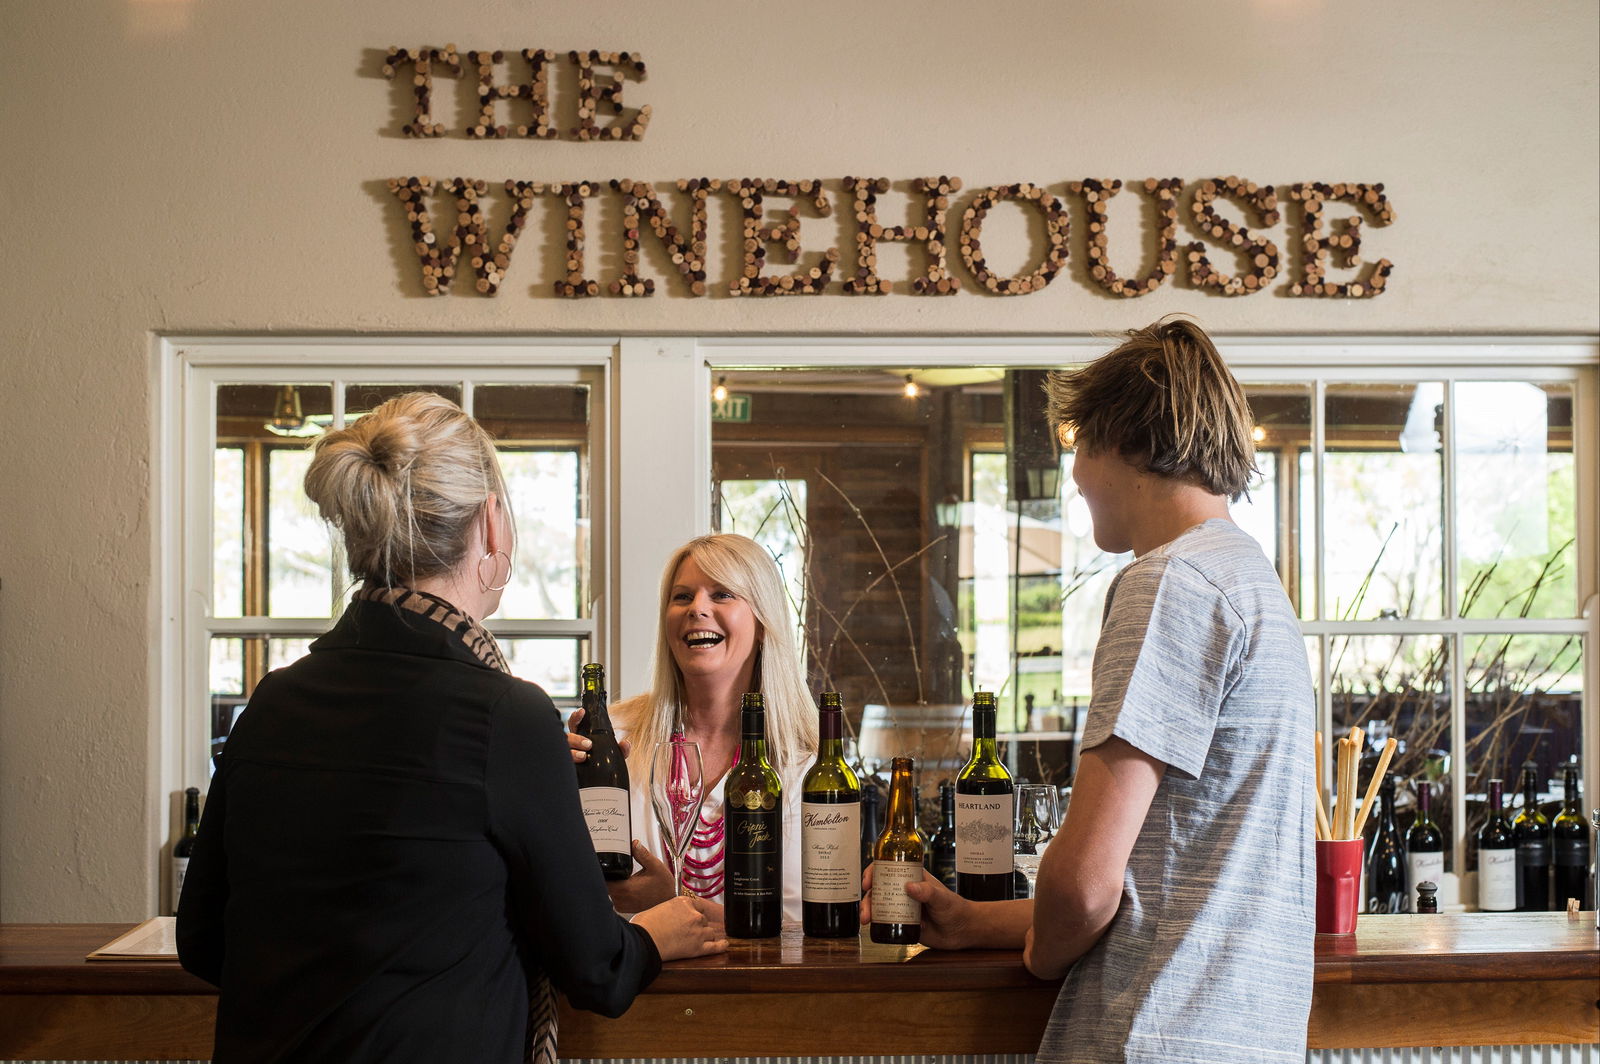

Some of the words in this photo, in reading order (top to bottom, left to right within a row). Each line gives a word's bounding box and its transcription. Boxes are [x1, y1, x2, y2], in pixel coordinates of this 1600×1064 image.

[383, 44, 652, 141] THE
[388, 175, 1396, 298] WINEHOUSE
[712, 398, 746, 418] XIT
[958, 802, 1001, 810] HEARTLAND
[804, 811, 850, 828] Kimbolton
